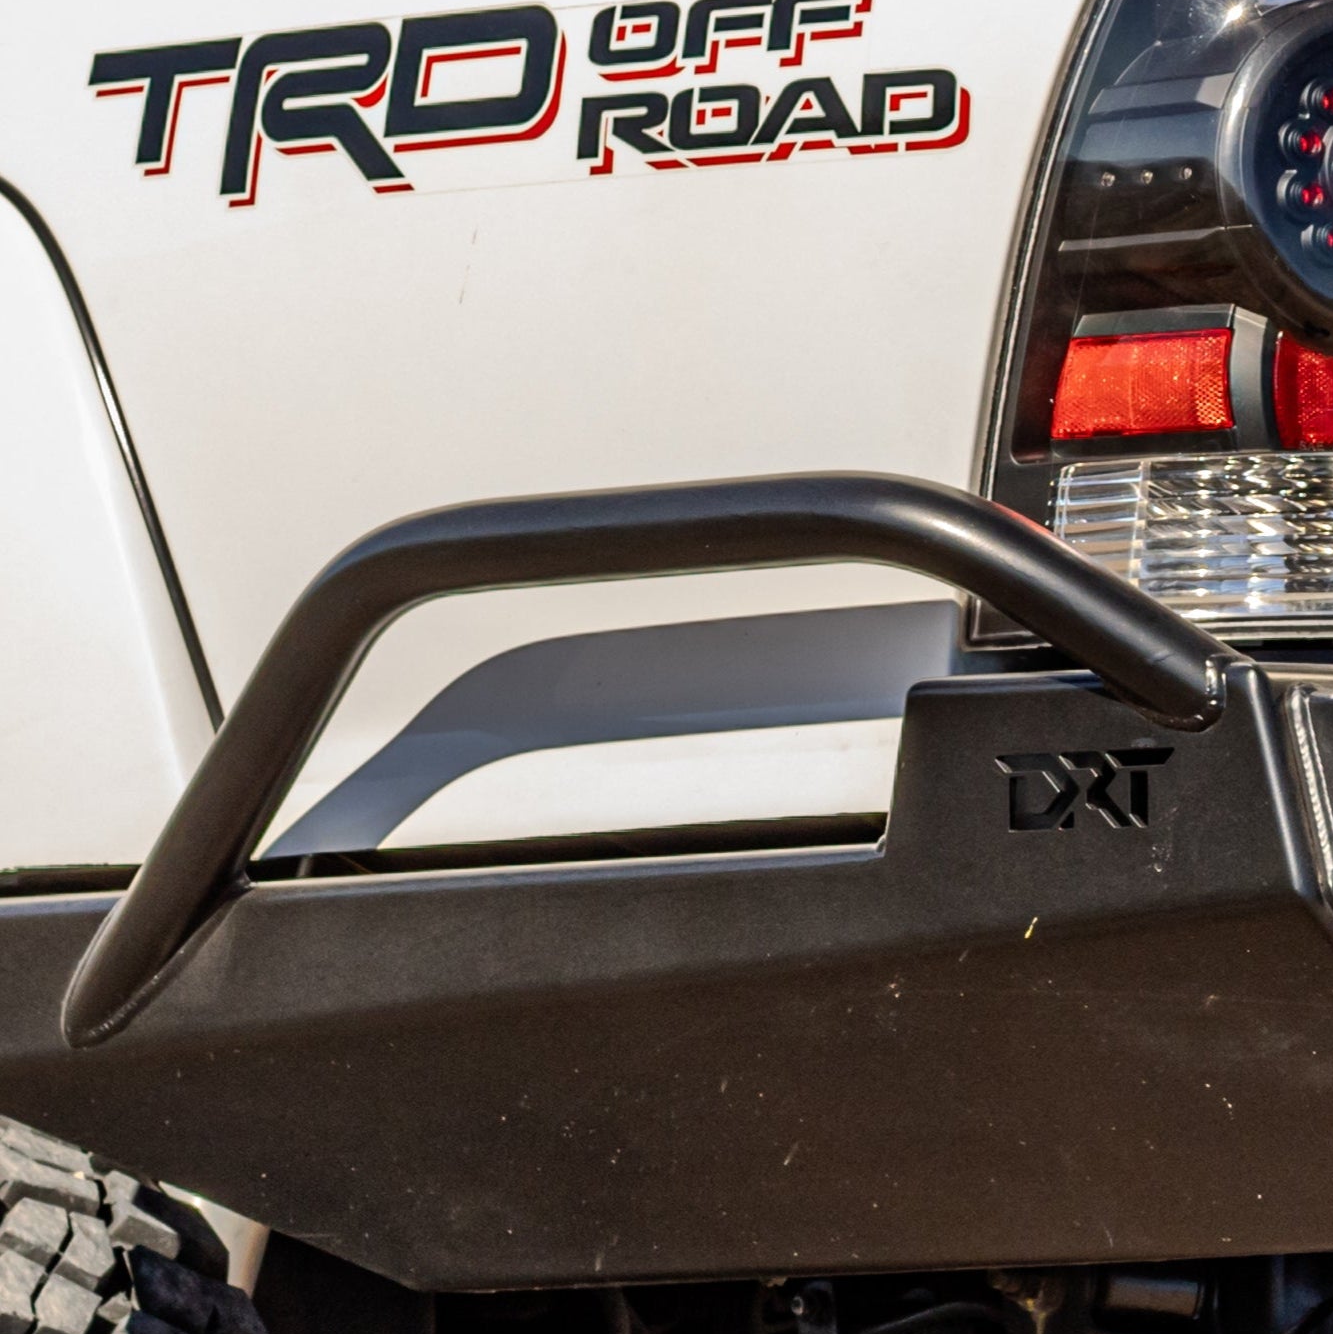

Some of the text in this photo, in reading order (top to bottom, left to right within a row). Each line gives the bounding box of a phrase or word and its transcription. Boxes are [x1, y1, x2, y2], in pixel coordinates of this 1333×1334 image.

[89, 5, 567, 210] TRD
[576, 68, 970, 176] ROAD
[995, 747, 1175, 833] DRT
